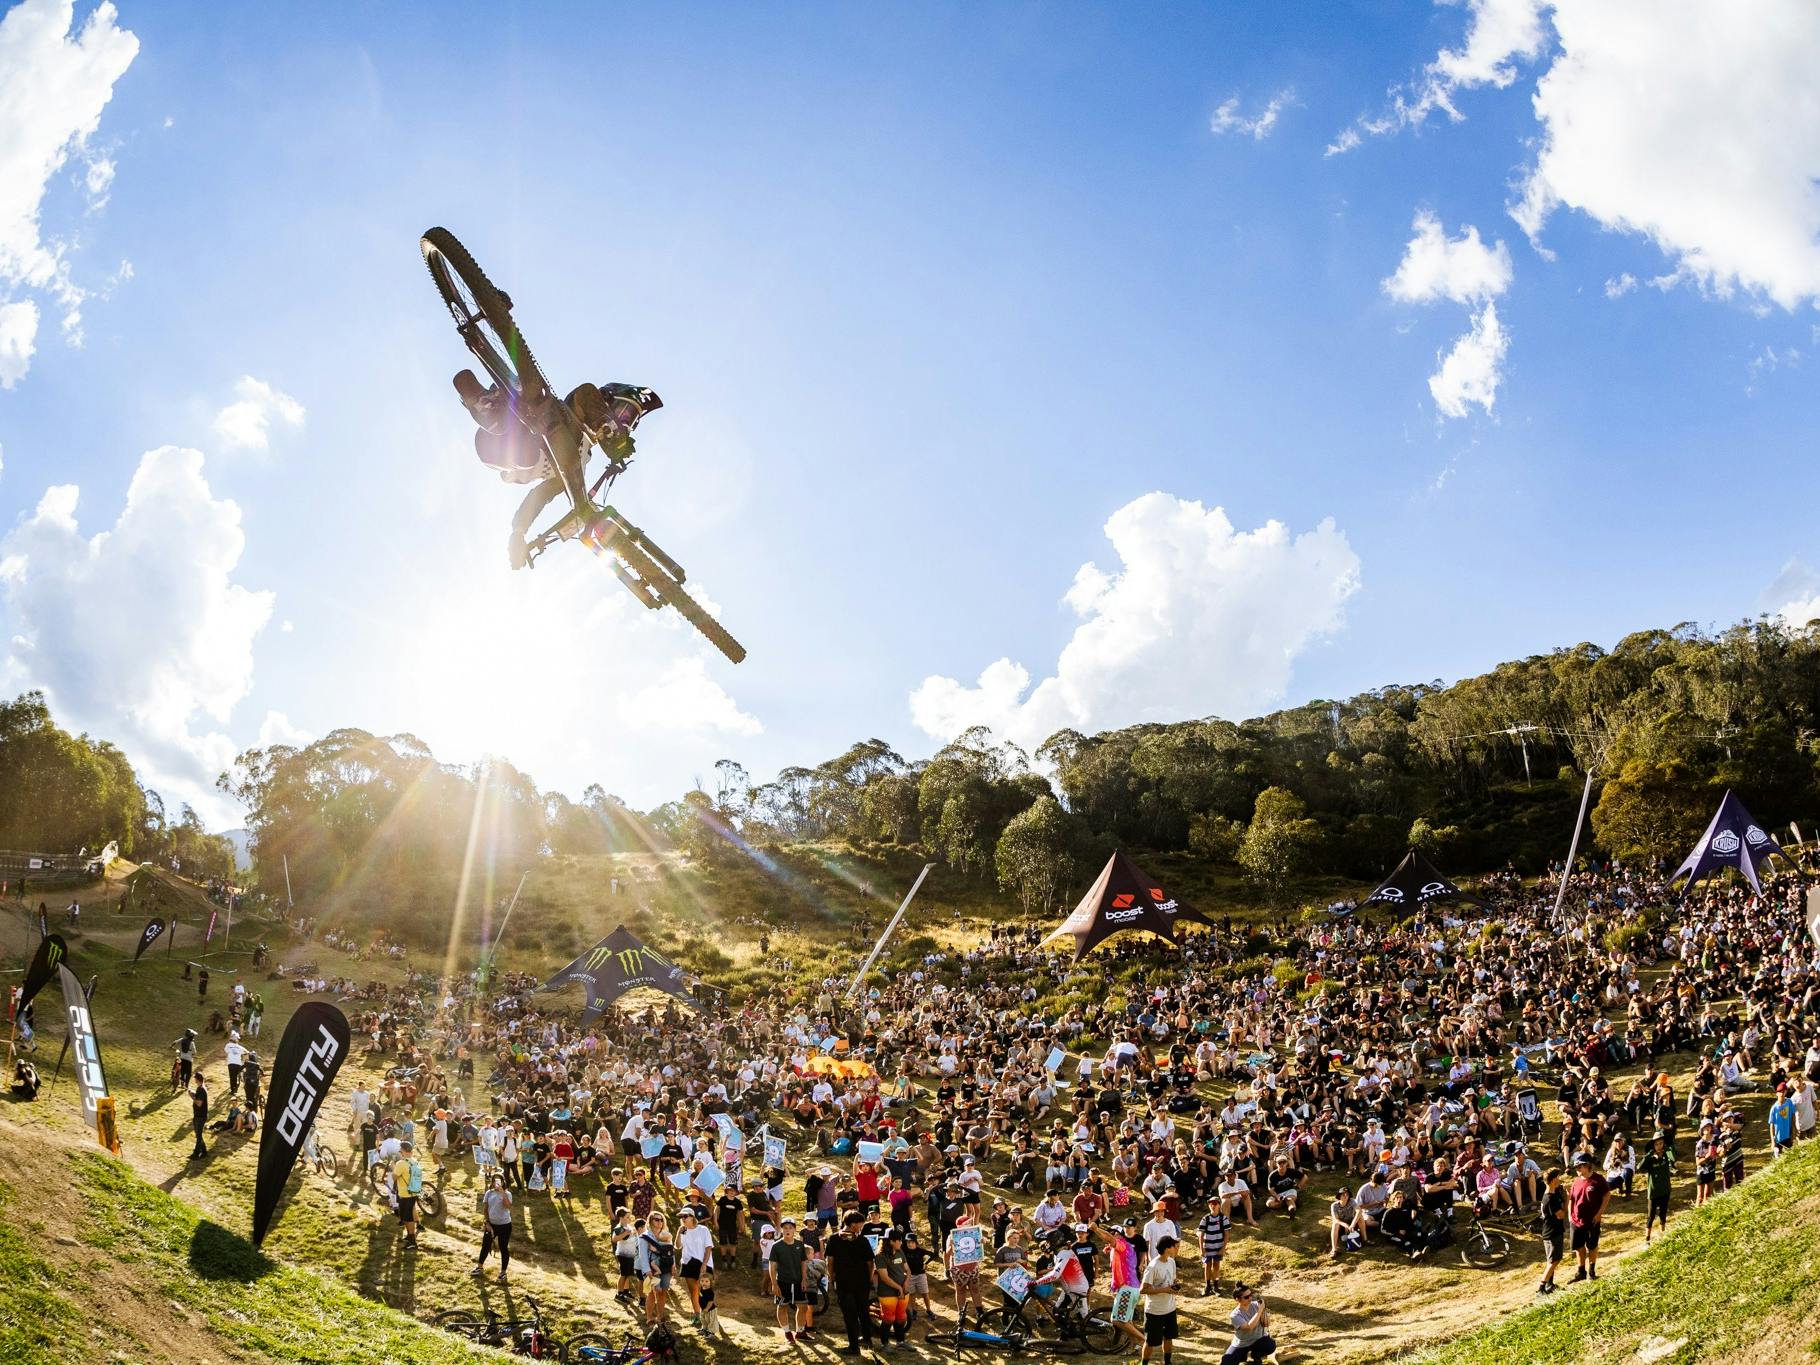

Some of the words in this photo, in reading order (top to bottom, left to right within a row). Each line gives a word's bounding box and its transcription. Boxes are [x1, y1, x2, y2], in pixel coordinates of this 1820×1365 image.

[1417, 889, 1452, 901] OAKLEY
[1105, 905, 1144, 920] boost
[617, 976, 656, 987] MONSTER
[276, 1024, 339, 1147] DEITY
[958, 1236, 976, 1254] 9
